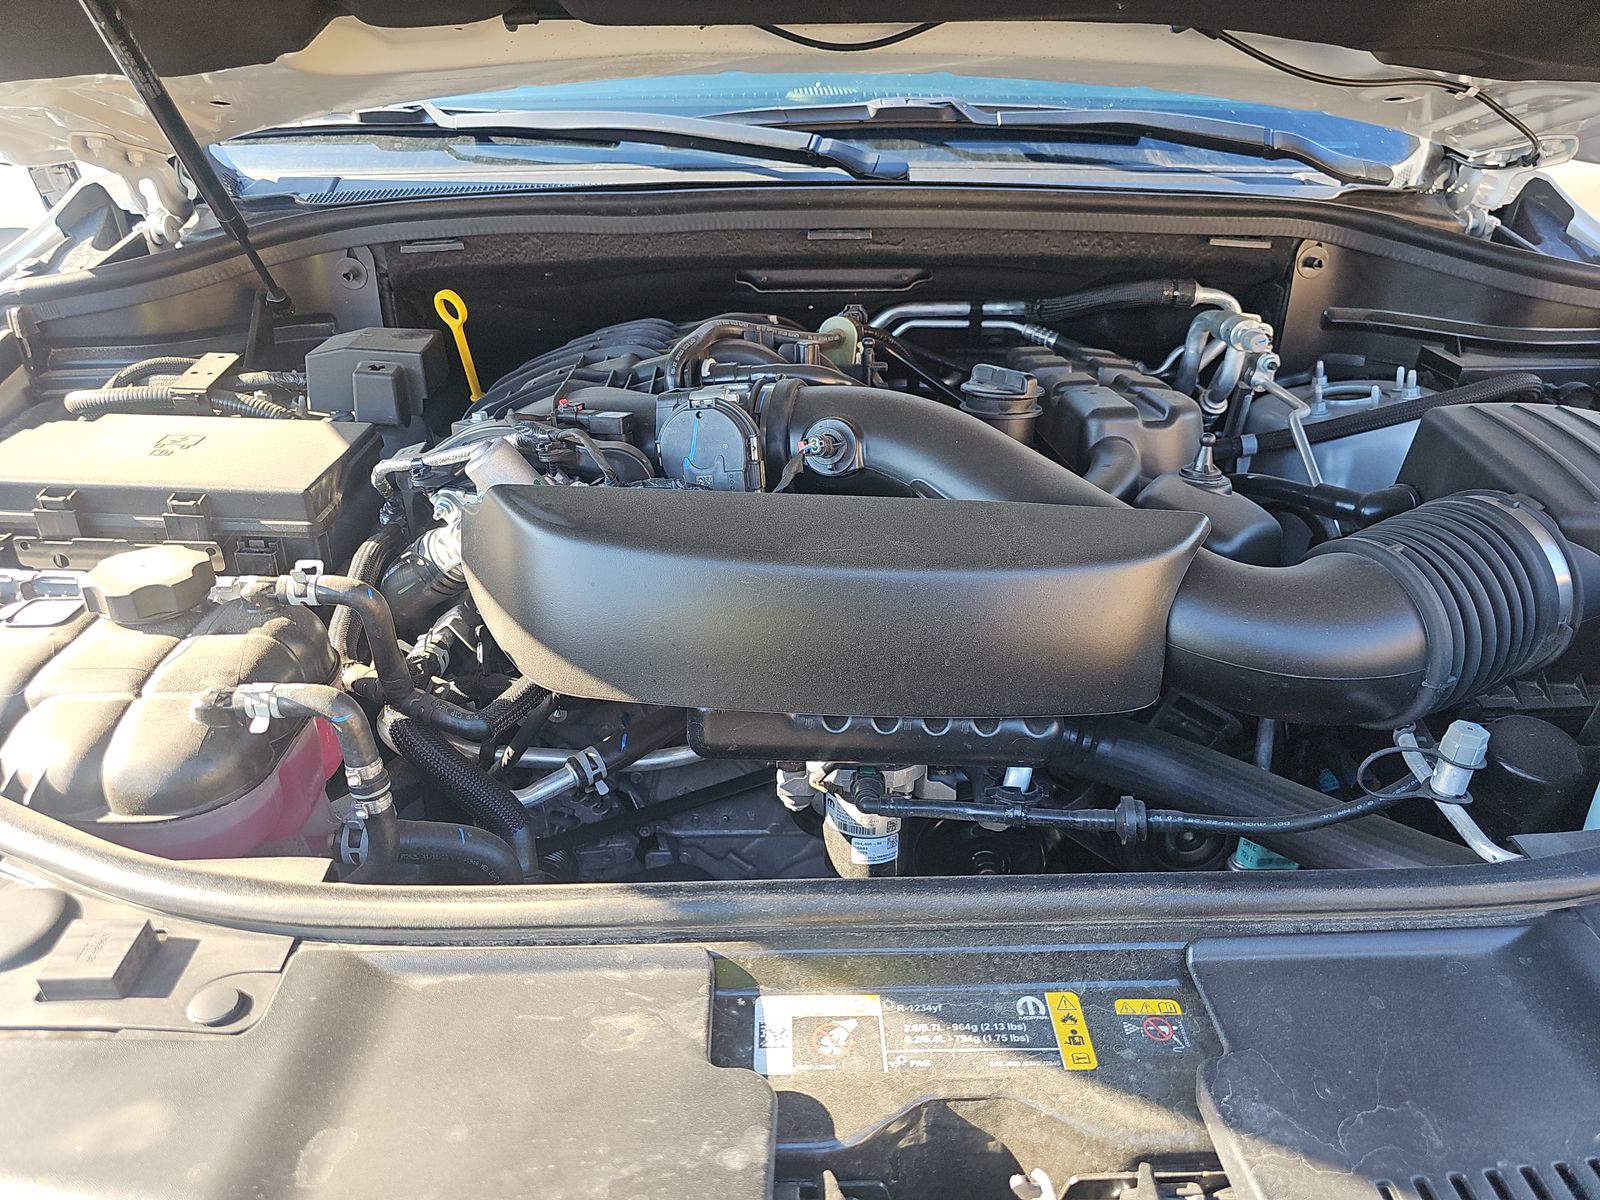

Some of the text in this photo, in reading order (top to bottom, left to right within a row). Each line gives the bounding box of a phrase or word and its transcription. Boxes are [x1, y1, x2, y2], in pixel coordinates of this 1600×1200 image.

[896, 1004, 942, 1014] R-1234yf
[952, 1023, 978, 1033] 964g
[980, 1022, 1005, 1033] (2.13
[1007, 1022, 1027, 1033] lbs)
[954, 1034, 981, 1044] 794g
[983, 1033, 1008, 1044] (1.75
[1009, 1033, 1030, 1044] lbs)
